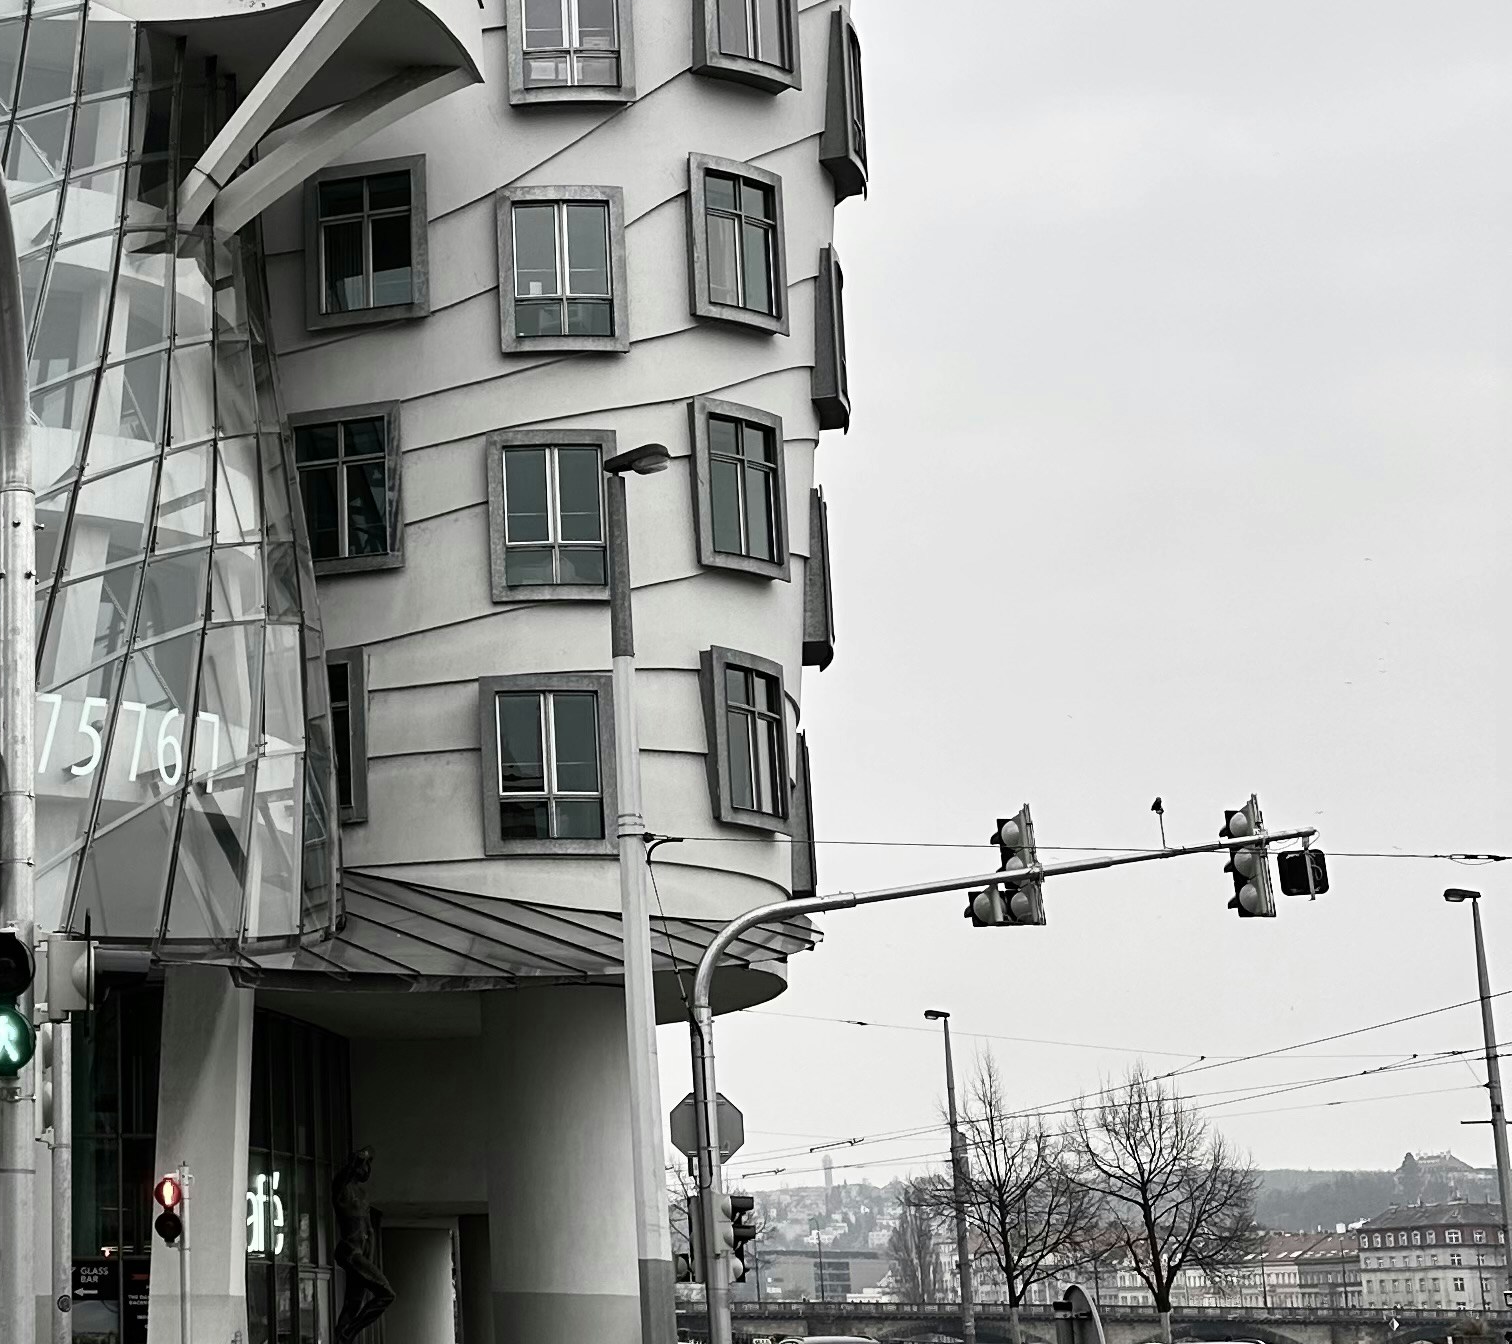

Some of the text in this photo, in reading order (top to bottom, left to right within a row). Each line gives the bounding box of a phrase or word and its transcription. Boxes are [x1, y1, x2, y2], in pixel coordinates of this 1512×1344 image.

[246, 1171, 284, 1255] afé
[80, 1267, 109, 1275] GLASS
[80, 1275, 99, 1283] BAR
